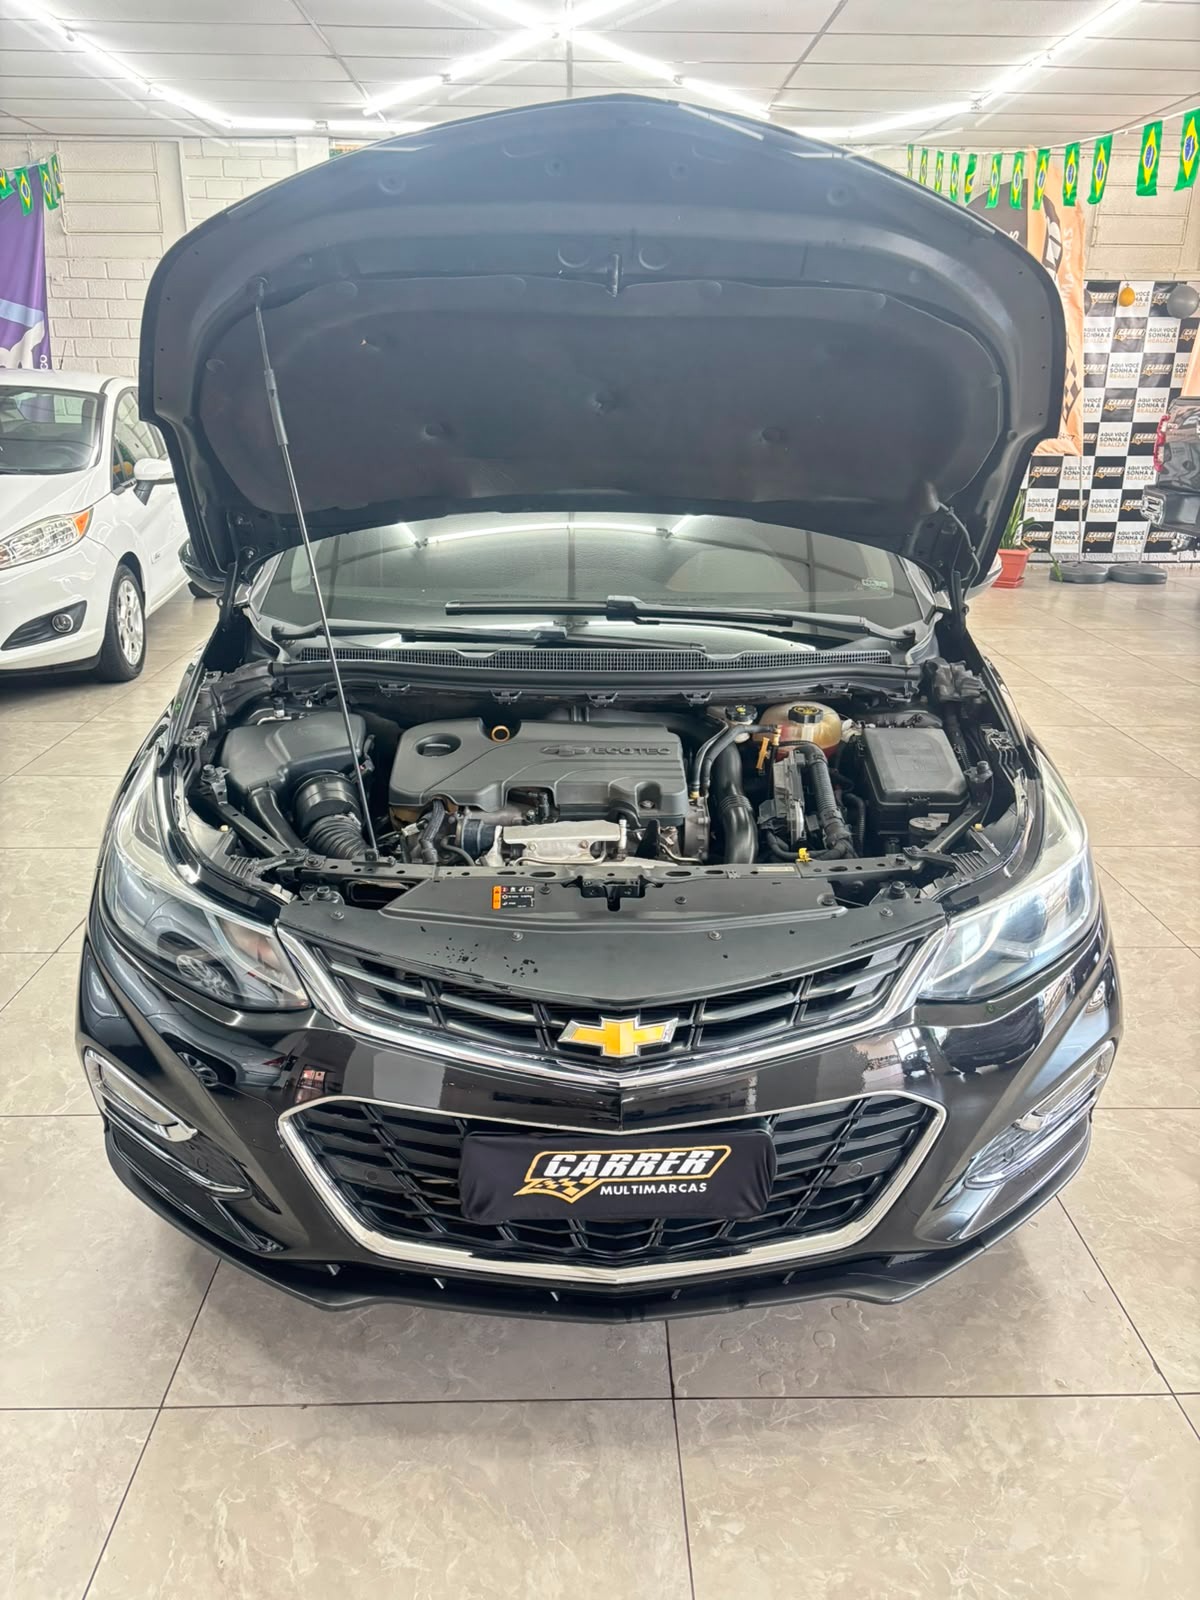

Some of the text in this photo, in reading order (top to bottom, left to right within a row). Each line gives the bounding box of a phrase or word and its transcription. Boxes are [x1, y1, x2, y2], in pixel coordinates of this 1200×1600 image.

[593, 746, 671, 756] ECOTEC
[543, 1150, 715, 1177] CARRER
[600, 1183, 707, 1195] MULTIMARCAS
